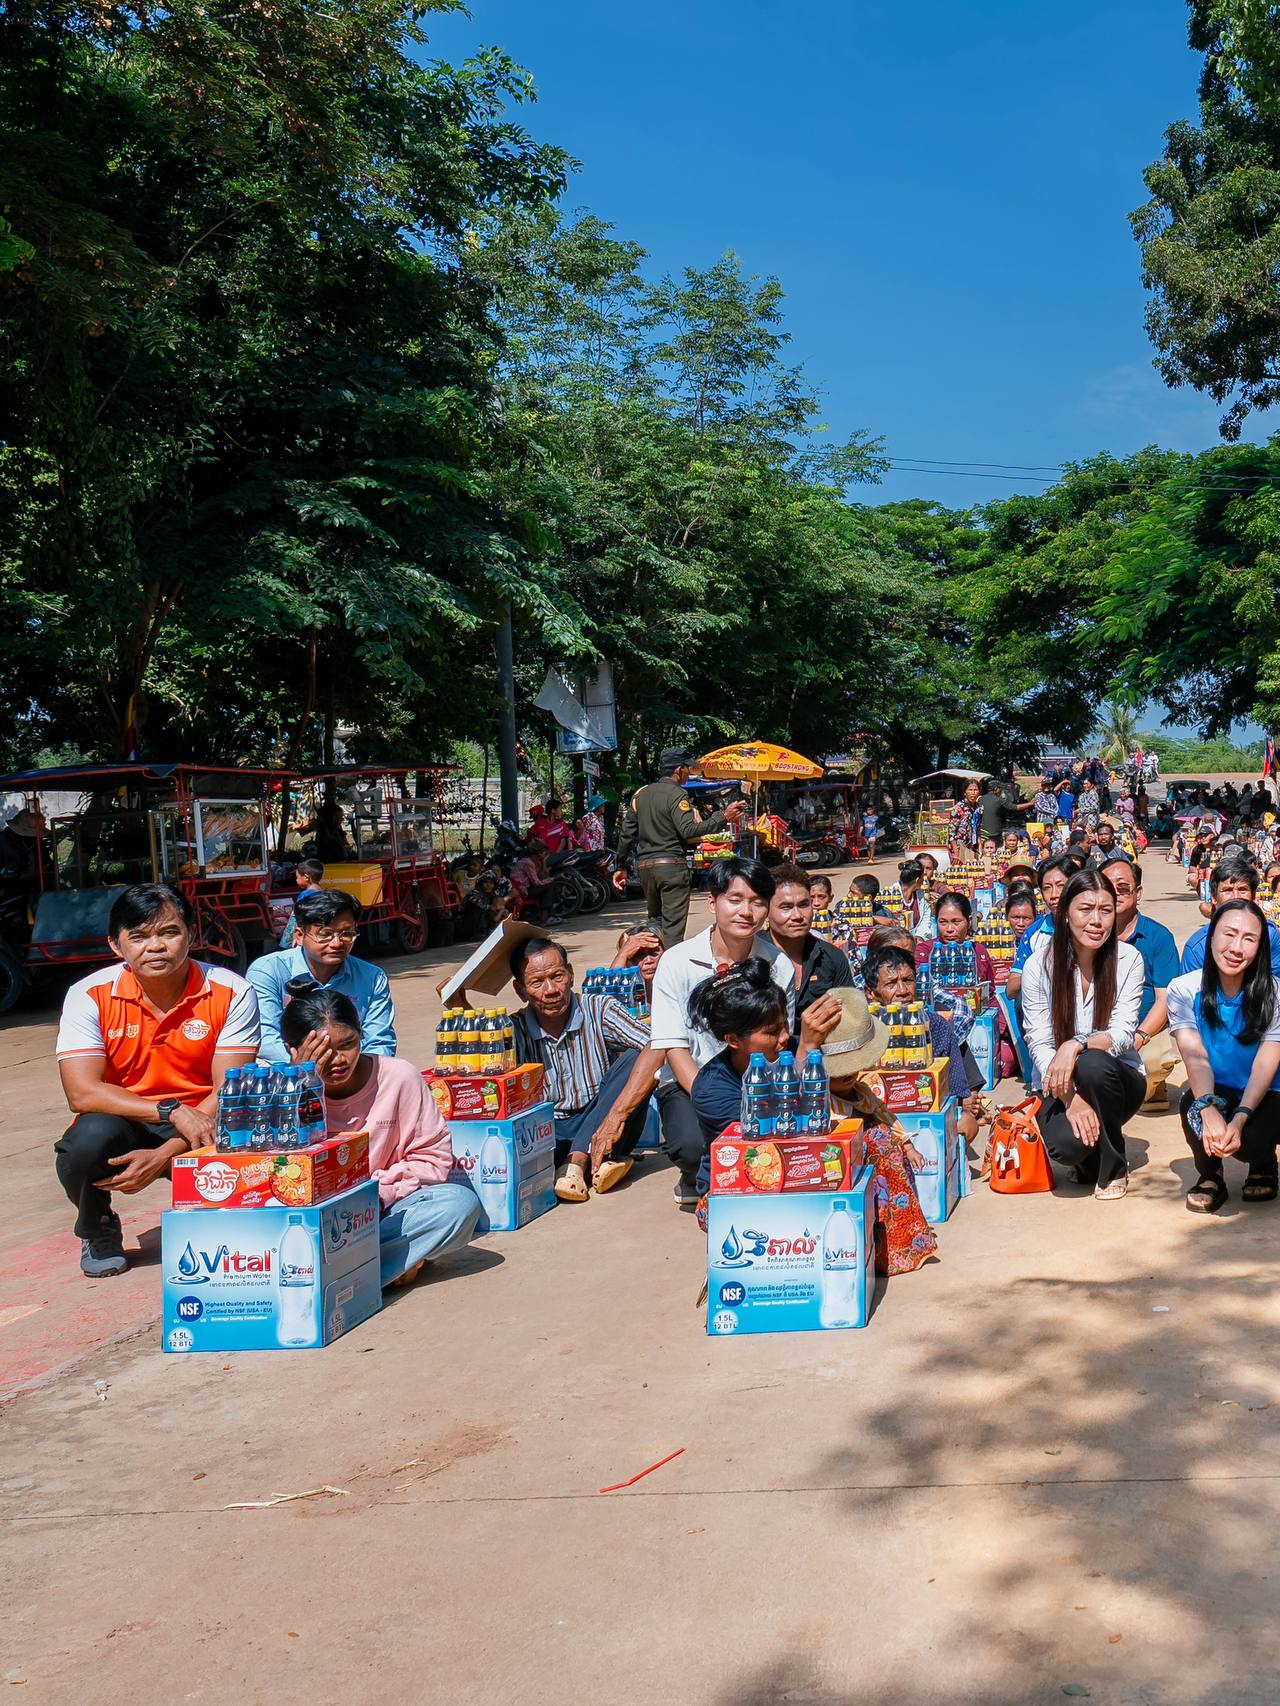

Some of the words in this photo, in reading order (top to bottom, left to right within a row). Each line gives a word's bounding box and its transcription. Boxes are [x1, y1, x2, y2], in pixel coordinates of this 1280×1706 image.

[527, 1122, 553, 1144] Vital
[488, 1164, 507, 1175] Vital
[193, 1166, 240, 1191] មីជាតិ
[743, 1228, 818, 1257] វីតាល់
[200, 1245, 271, 1273] Vital
[832, 1248, 857, 1259] Vital
[722, 1289, 742, 1301] NSF
[179, 1303, 199, 1316] NSF
[205, 1301, 225, 1309] Highest
[256, 1300, 273, 1308] Safety
[173, 1332, 189, 1340] 1.5L
